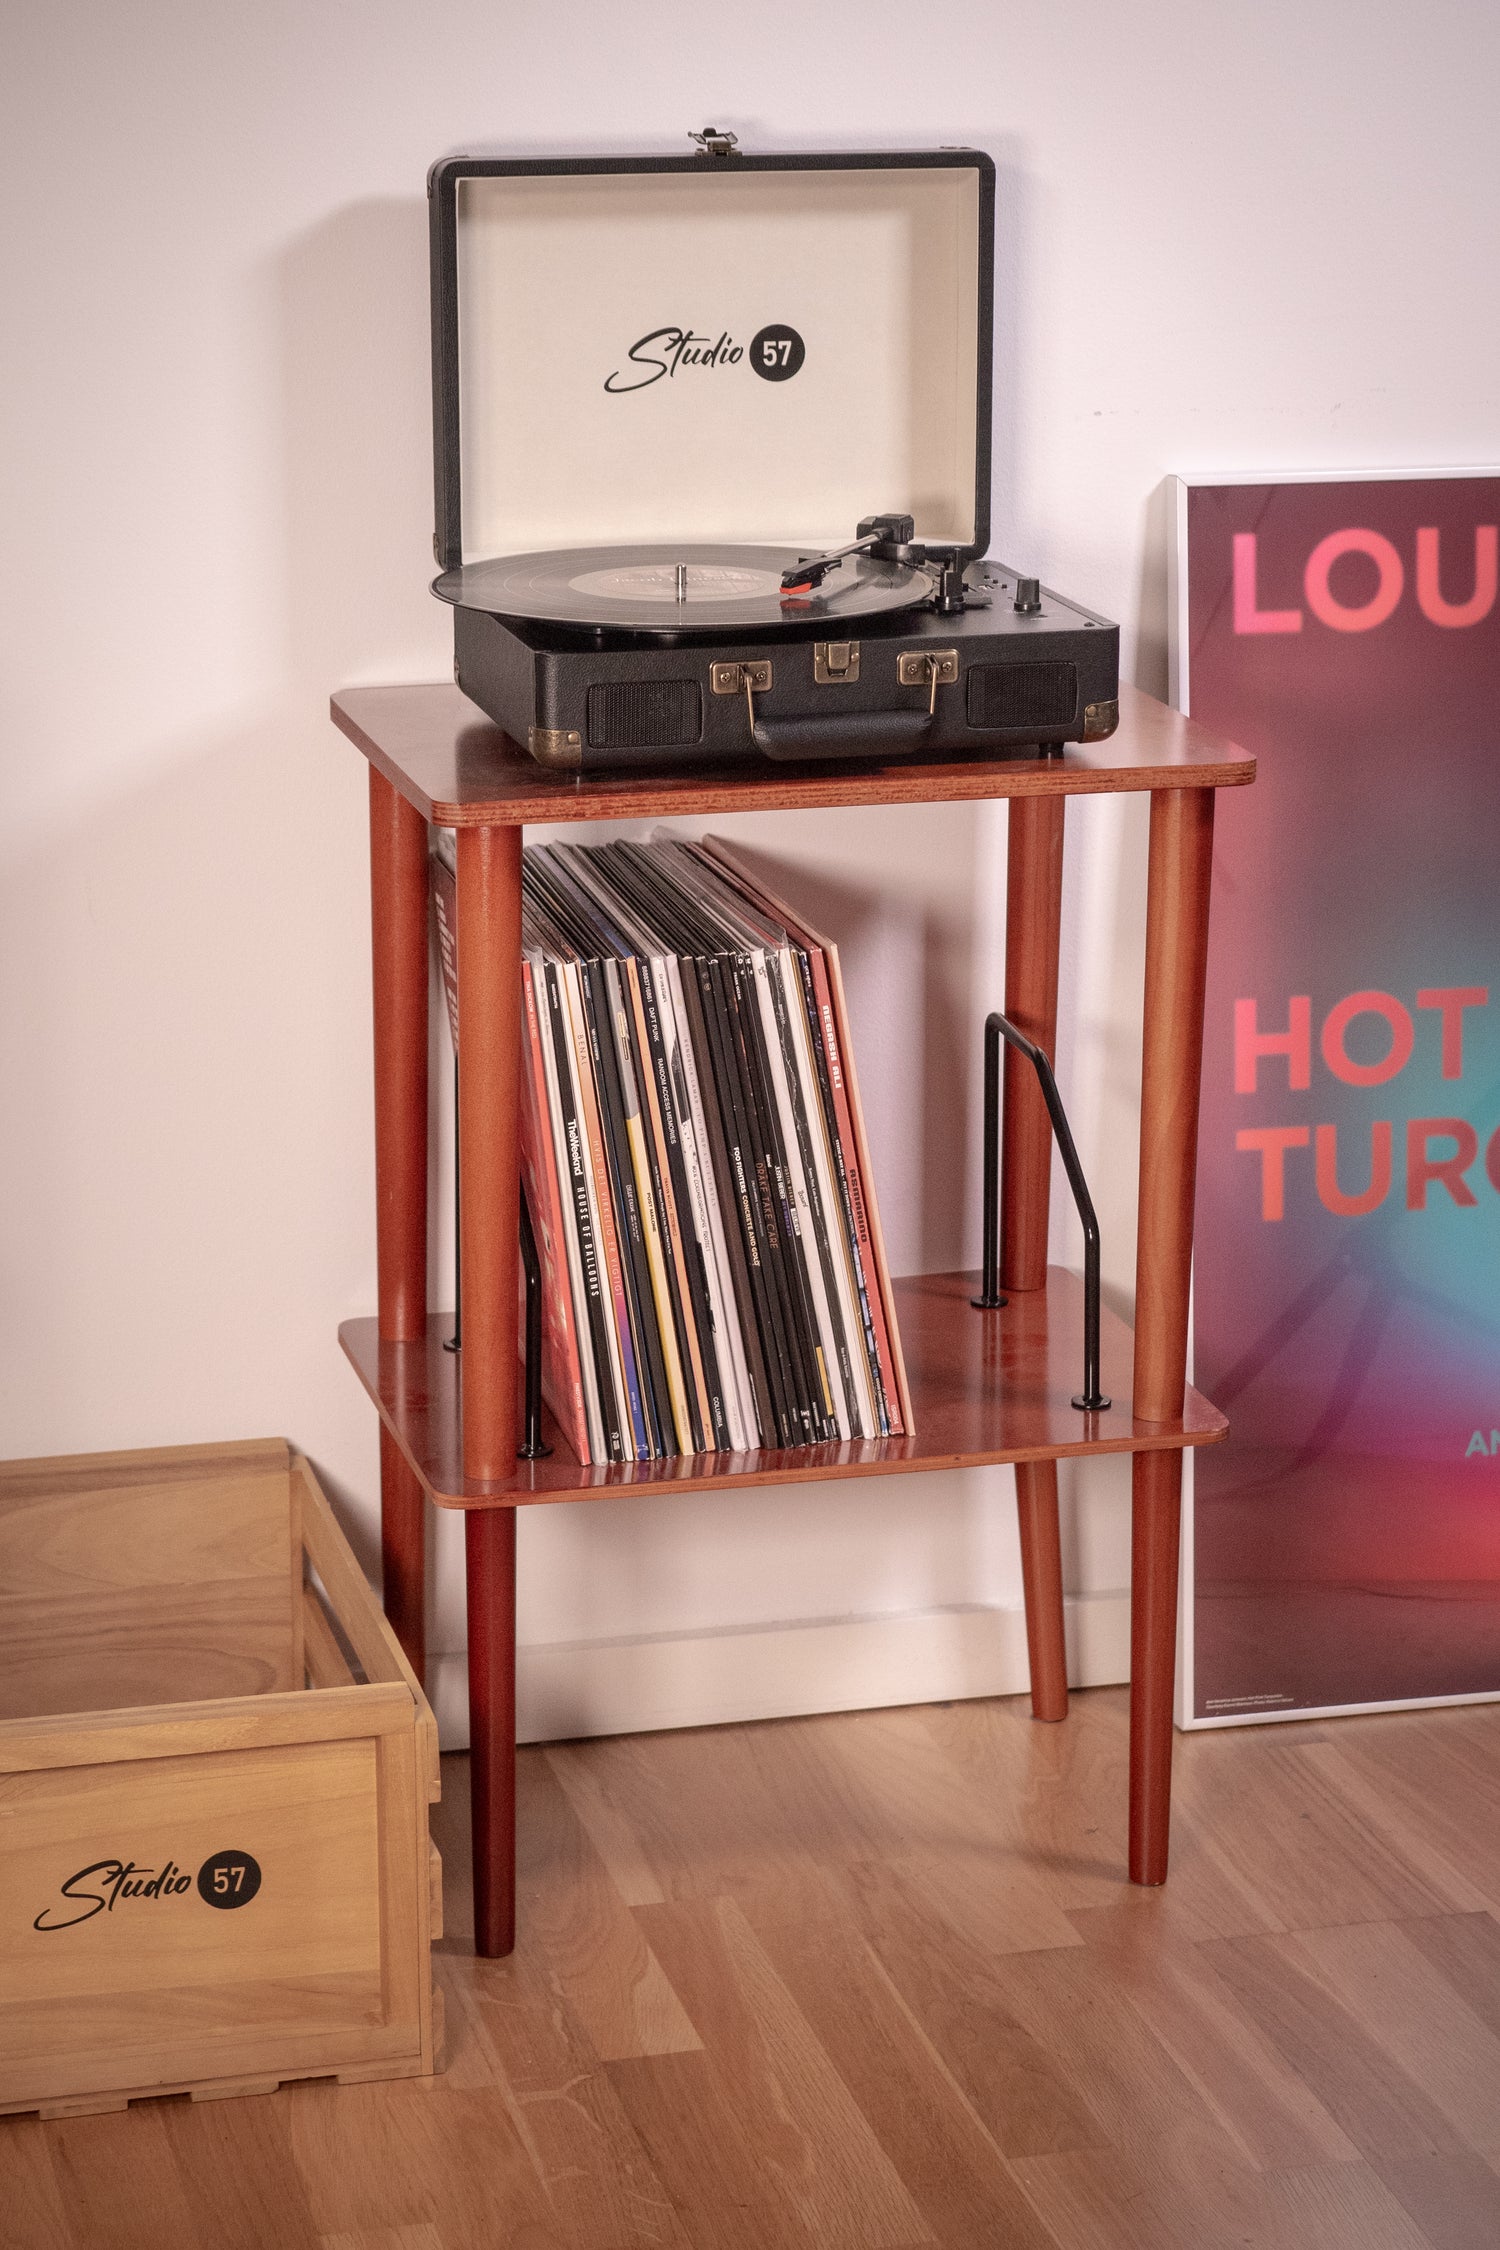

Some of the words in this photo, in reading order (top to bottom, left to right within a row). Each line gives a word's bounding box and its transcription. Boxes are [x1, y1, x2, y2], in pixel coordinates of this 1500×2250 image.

[603, 326, 745, 394] Studio
[762, 340, 793, 367] 57
[1232, 525, 1498, 635] LOU
[648, 1006, 656, 1023] DAFT
[651, 1023, 659, 1042] PUNK
[1234, 985, 1489, 1095] HOT
[576, 1033, 587, 1065] BENAL
[657, 1057, 666, 1085] RANDOM
[683, 1038, 693, 1076] KENDRICK
[690, 1078, 699, 1104] LAMAR
[661, 1085, 670, 1110] ACCESS
[665, 1110, 676, 1145] MEMORIES
[820, 1004, 838, 1062] NEGASH
[830, 1064, 842, 1089] ALI
[847, 1168, 868, 1243] ASMARINO
[591, 1139, 603, 1163] HVIS
[732, 1146, 741, 1162] FOO
[596, 1167, 605, 1185] DET
[735, 1161, 747, 1193] FIGHTERS
[754, 1161, 767, 1193] DRAKE
[1235, 1116, 1500, 1222] TUR
[576, 1186, 588, 1220] HOUSE
[599, 1191, 613, 1236] VIRKELIG
[645, 1191, 653, 1208] POST
[740, 1194, 753, 1230] CONCRETE
[761, 1196, 772, 1220] TAKE
[581, 1225, 591, 1238] OF
[648, 1208, 657, 1233] MALONE
[766, 1222, 778, 1250] CARE
[607, 1240, 616, 1252] ER
[747, 1230, 756, 1246] AND
[584, 1243, 599, 1296] BALLOONS
[749, 1246, 760, 1267] GOLD
[609, 1257, 622, 1297] VIGTIGT
[712, 1395, 723, 1428] COLUMBIA
[33, 1859, 192, 1932] Studio
[213, 1866, 247, 1894] 57
